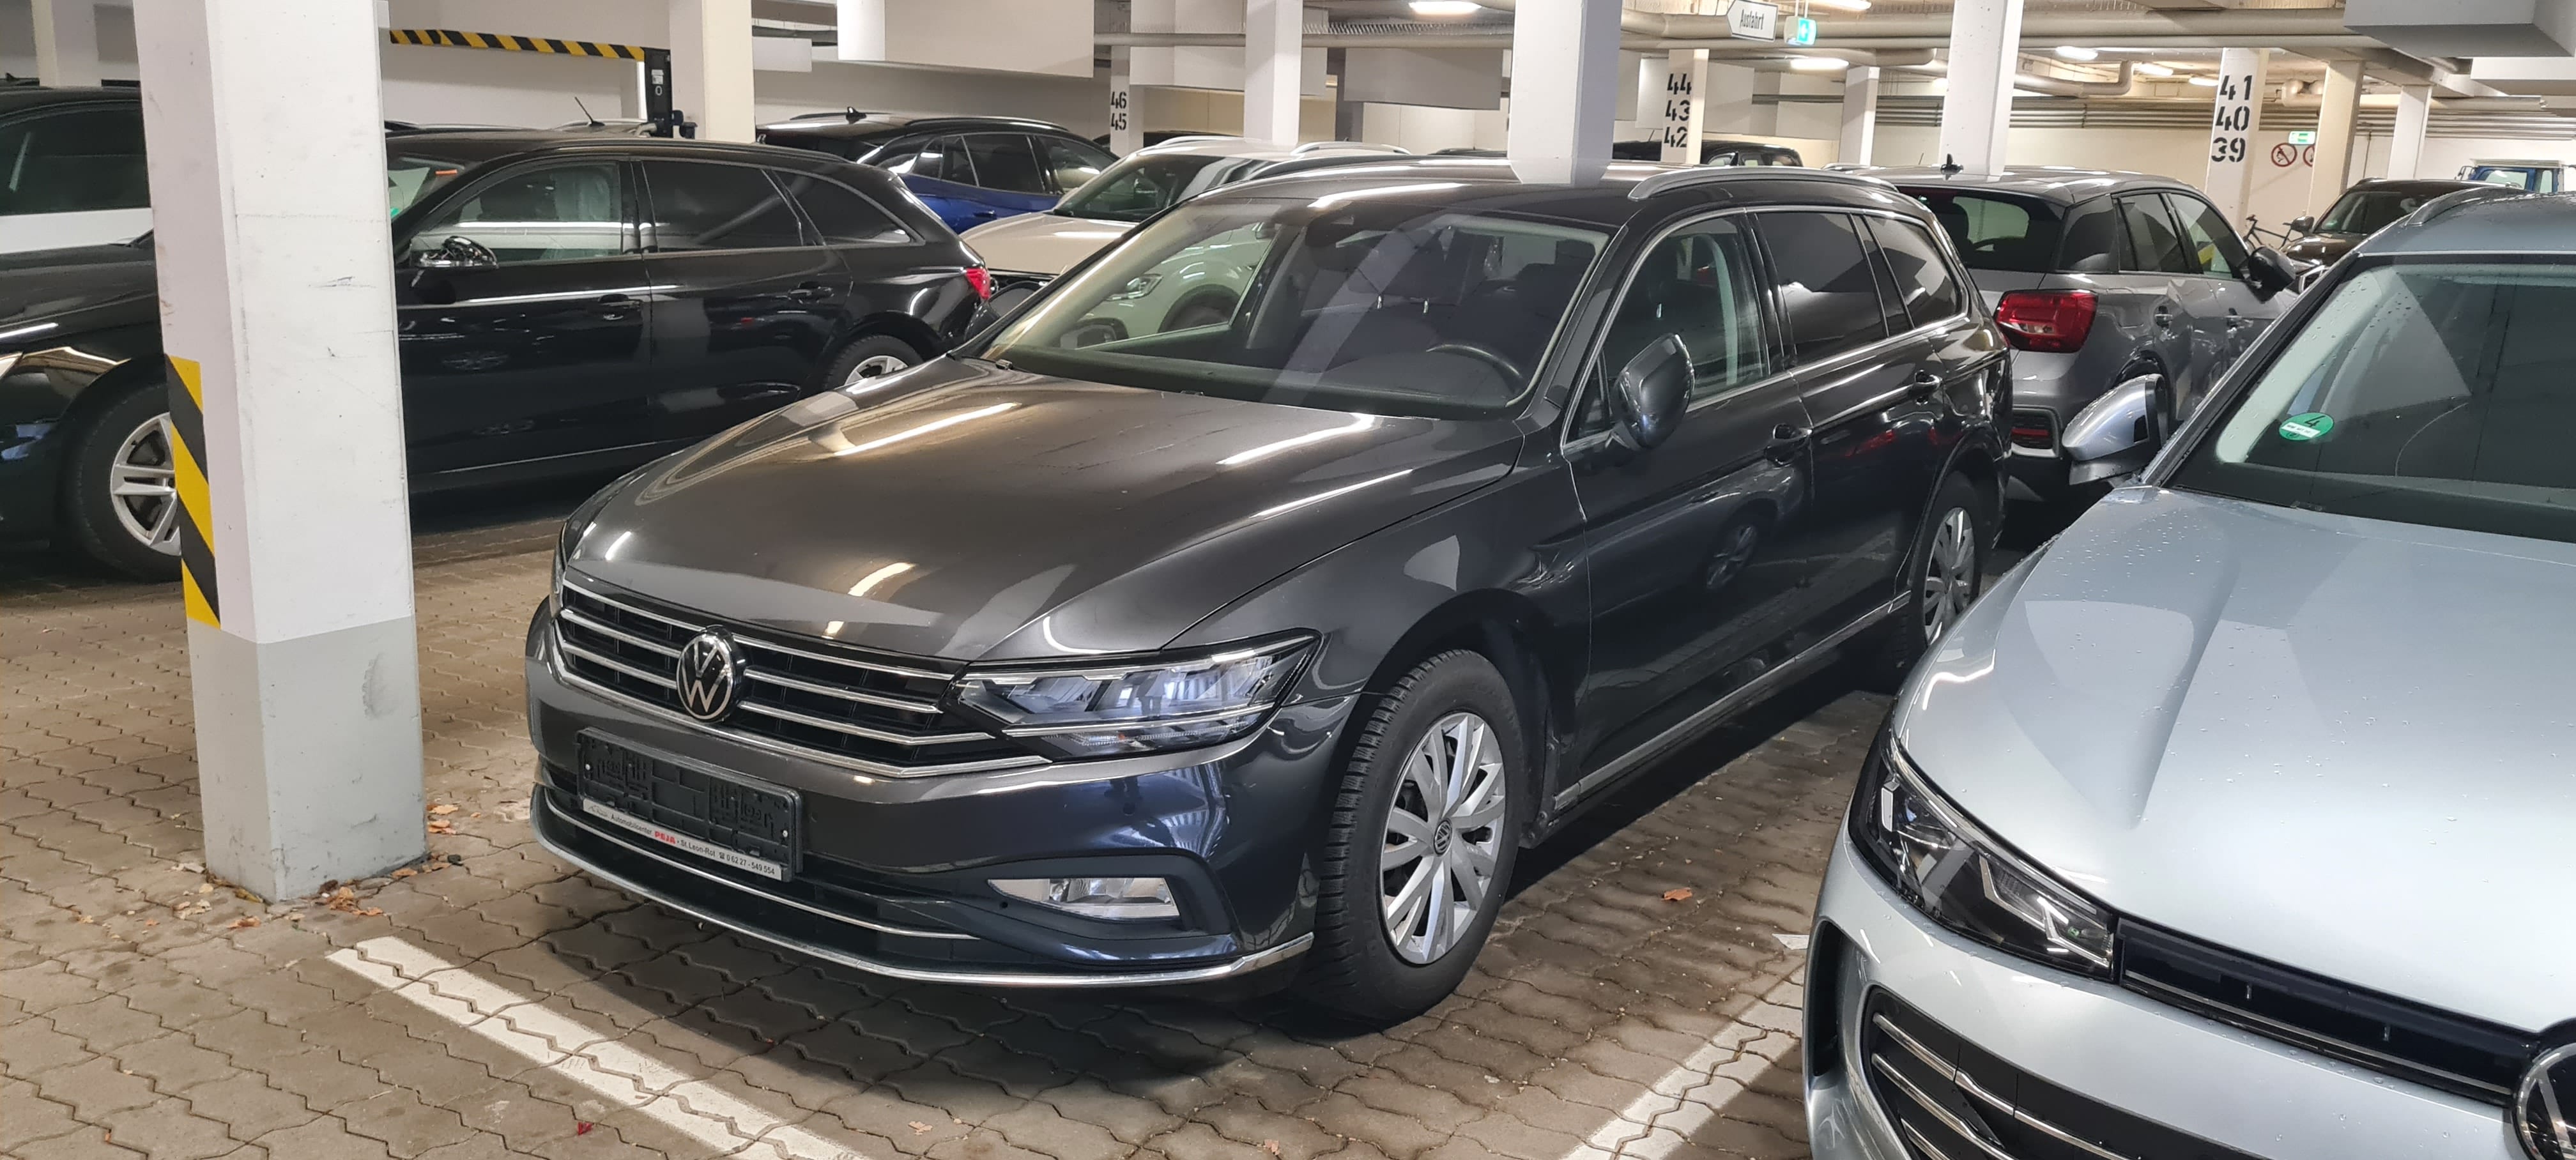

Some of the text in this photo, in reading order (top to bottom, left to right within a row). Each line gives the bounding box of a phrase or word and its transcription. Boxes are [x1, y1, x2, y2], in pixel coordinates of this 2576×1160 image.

[1740, 9, 1764, 30] Ausfahrt
[1667, 73, 1692, 95] 44
[2220, 75, 2252, 100] 41
[1111, 91, 1127, 109] 46
[1665, 100, 1690, 121] 43
[1111, 113, 1127, 130] 45
[2216, 106, 2250, 131] 40
[1664, 126, 1688, 148] 42
[2211, 137, 2246, 162] 39
[2304, 415, 2326, 427] 4
[678, 636, 731, 718] VW
[654, 830, 676, 845] PEJA
